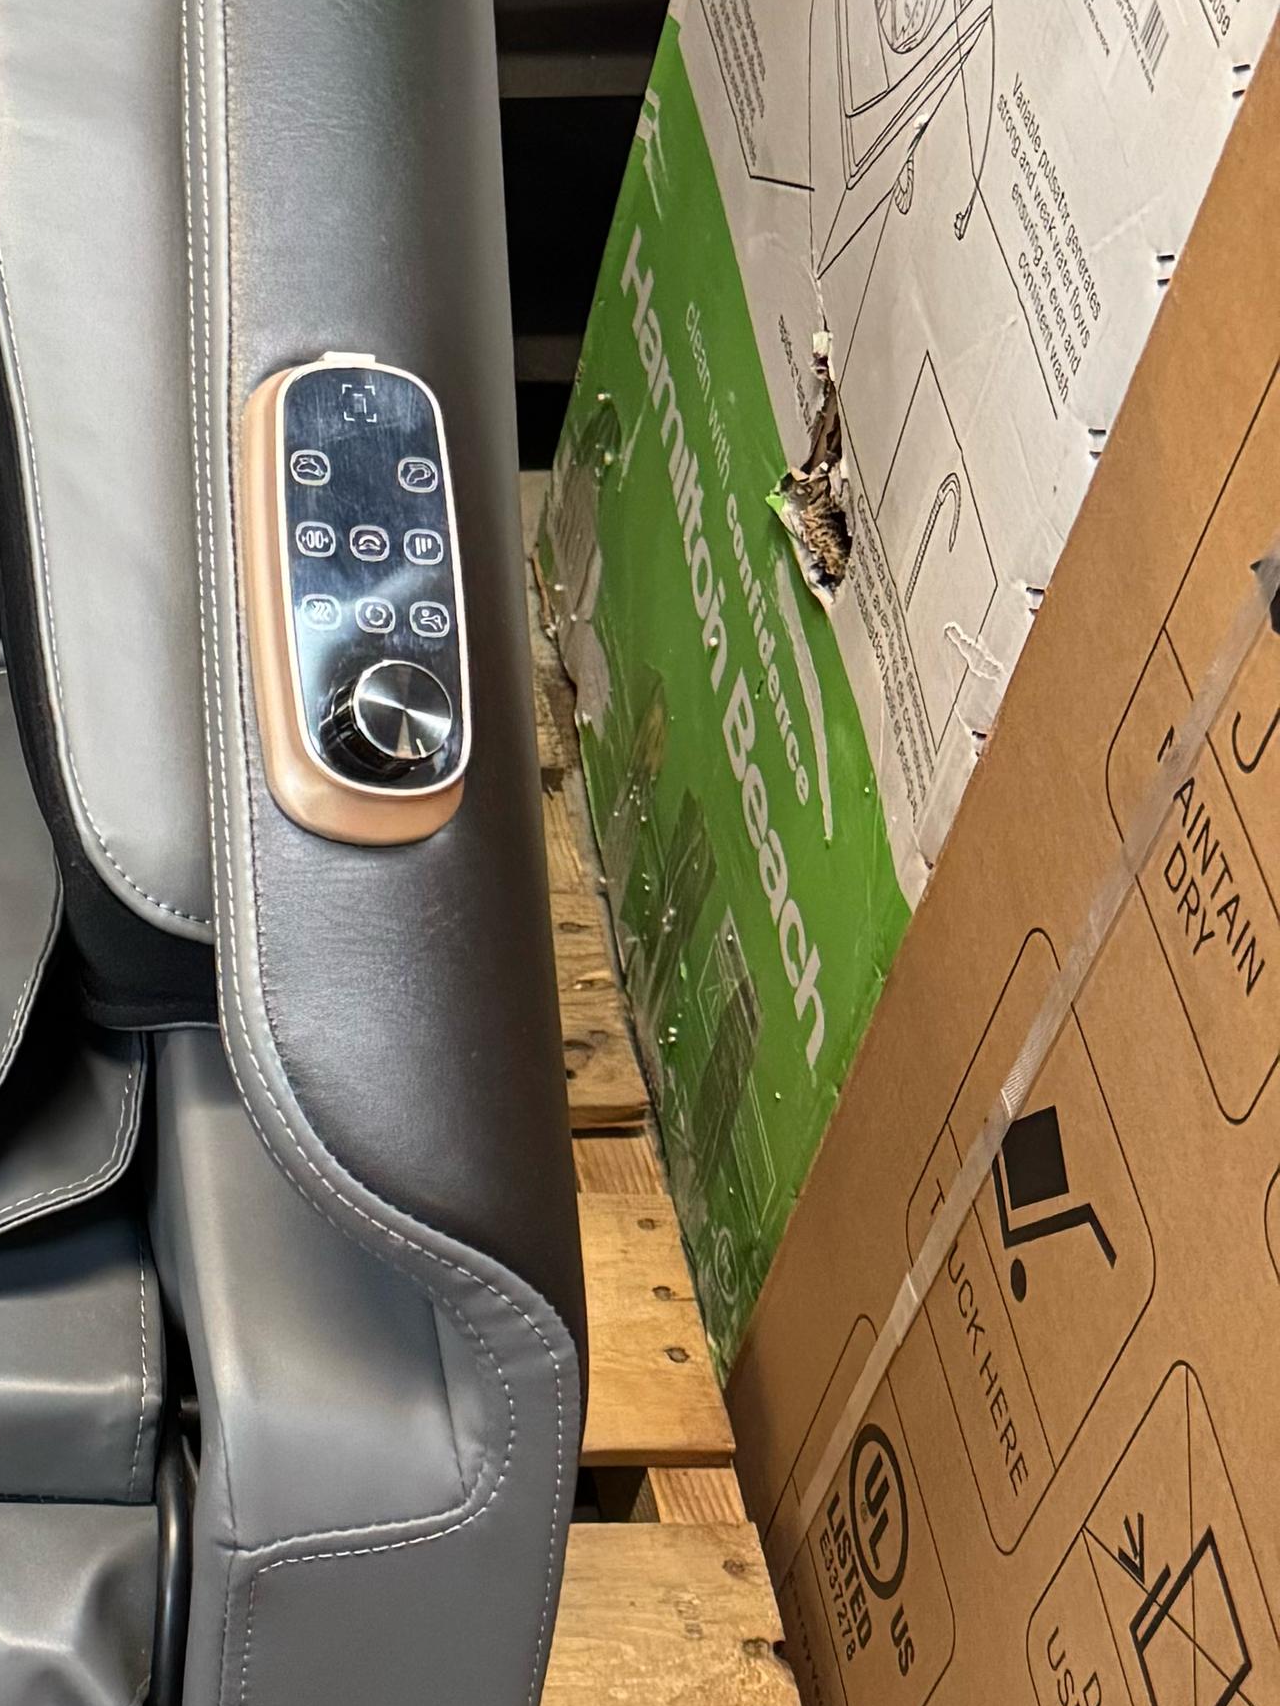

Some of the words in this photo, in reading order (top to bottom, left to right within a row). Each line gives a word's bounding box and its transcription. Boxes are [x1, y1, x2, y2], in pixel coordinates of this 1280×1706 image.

[997, 94, 1021, 157] strong
[1019, 151, 1036, 190] and
[1034, 186, 1056, 239] weak
[1052, 237, 1072, 292] water
[1069, 286, 1090, 348] flows
[1011, 183, 1043, 266] ensuring
[1041, 261, 1051, 288] an
[1049, 287, 1066, 337] even
[1064, 334, 1081, 375] and
[1013, 73, 1041, 152] Variable
[1066, 225, 1100, 319] generates
[1050, 346, 1068, 403] wash
[619, 227, 729, 690] Hamilton
[722, 667, 824, 1071] Beach
[686, 302, 713, 409] clean
[707, 412, 732, 492] with
[726, 493, 809, 806] confidence
[1157, 725, 1266, 995] AINTAIN
[1163, 841, 1216, 956] DRY
[930, 1178, 986, 1360] TUCK
[981, 1351, 1030, 1497] HERE
[818, 1530, 858, 1663] E337278
[825, 1494, 873, 1652] LISTED
[890, 1609, 917, 1678] US
